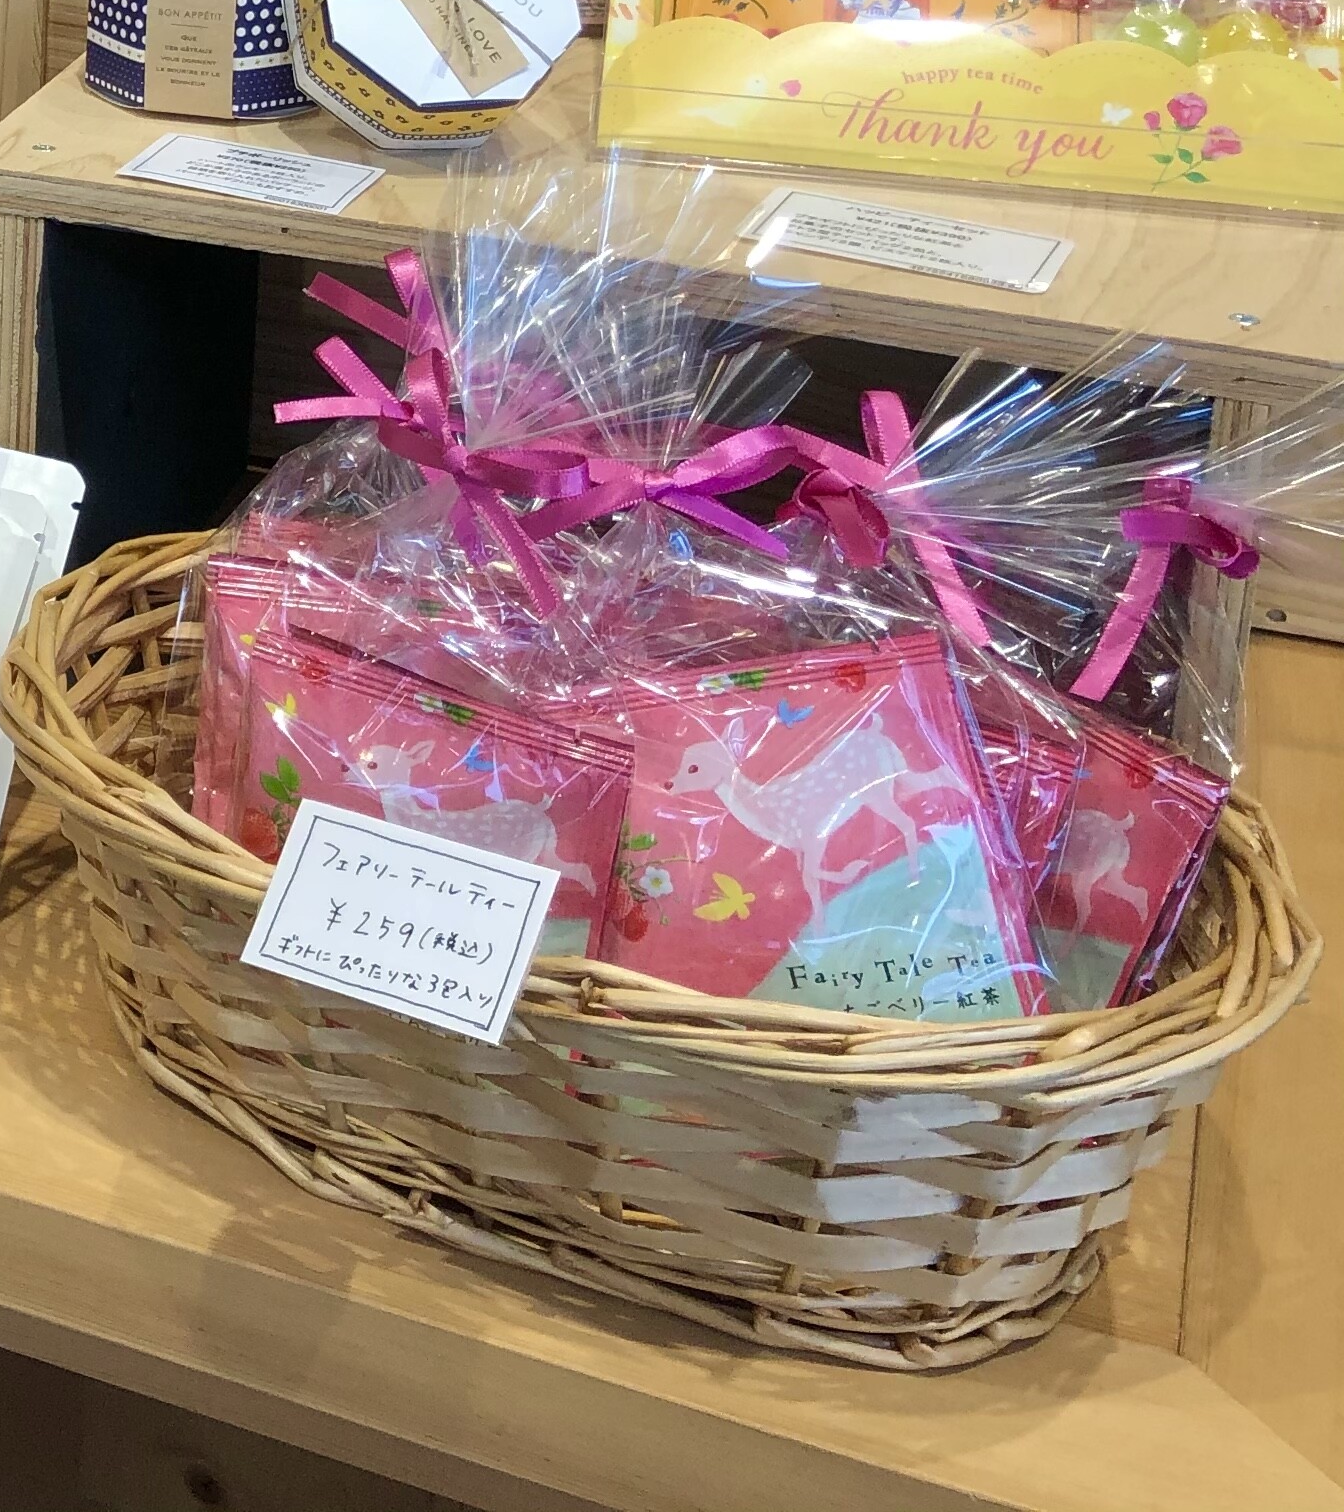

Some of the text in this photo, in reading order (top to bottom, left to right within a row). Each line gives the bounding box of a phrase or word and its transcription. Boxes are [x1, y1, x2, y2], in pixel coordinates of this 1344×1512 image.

[158, 8, 180, 18] BON
[902, 68, 1044, 95] happy tea time
[822, 87, 1114, 178] Thank you
[326, 897, 494, 966] ¥259(税込)
[785, 951, 997, 990] Fairy Tale Tea
